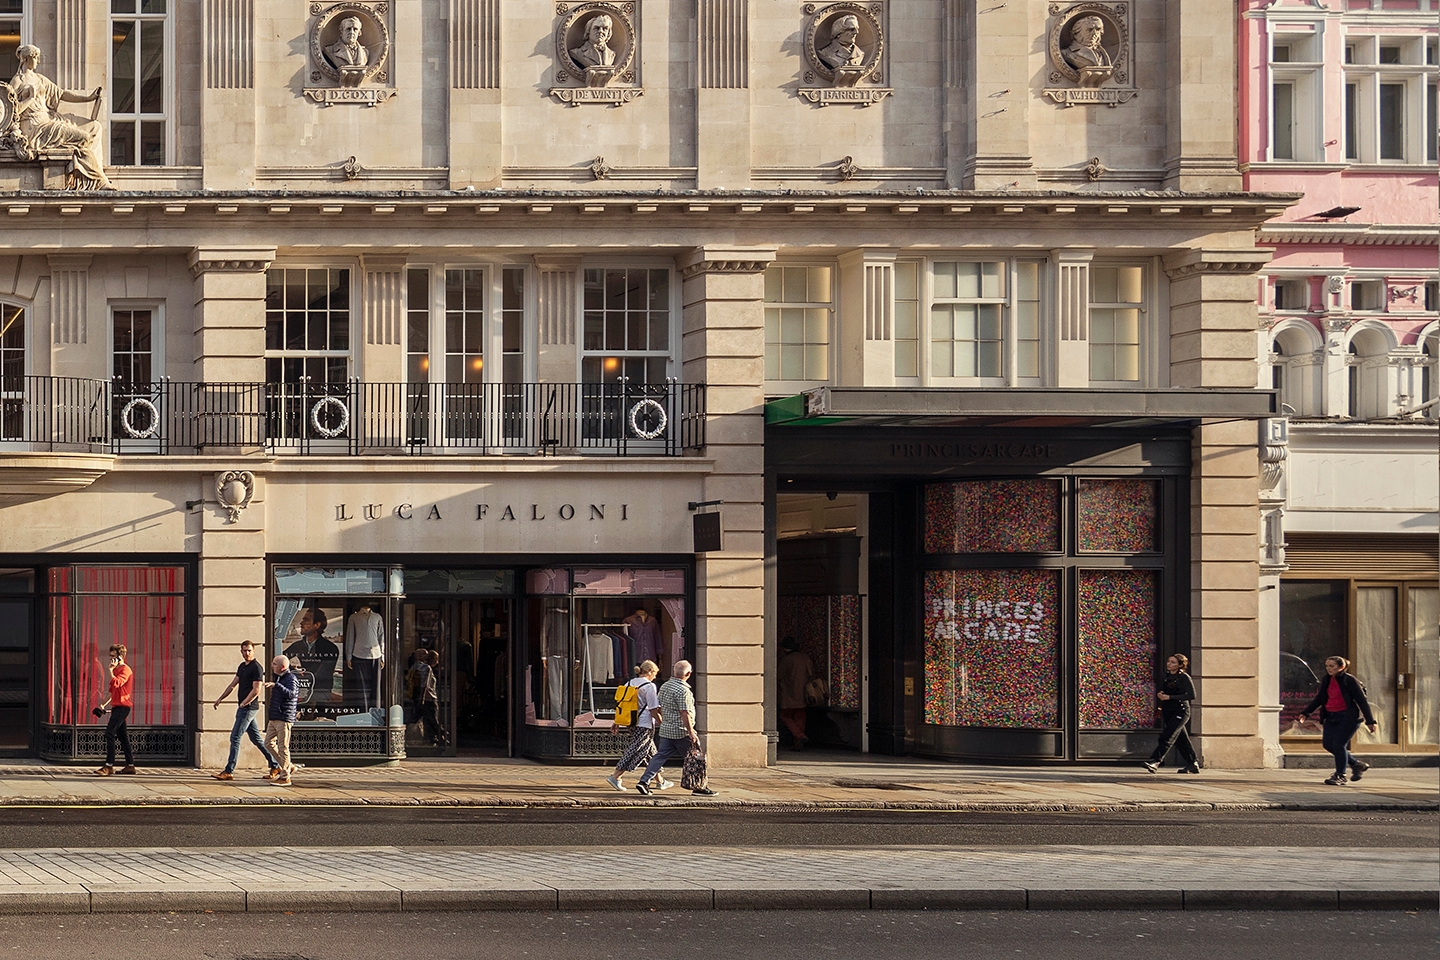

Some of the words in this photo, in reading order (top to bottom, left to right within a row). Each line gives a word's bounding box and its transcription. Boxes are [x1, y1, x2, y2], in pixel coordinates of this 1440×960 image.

[576, 89, 588, 100] DE
[591, 89, 620, 100] WINT
[337, 503, 442, 521] LUCA
[476, 503, 629, 521] FALONI
[933, 599, 1044, 621] PRINCES
[934, 621, 1041, 643] ARCADE
